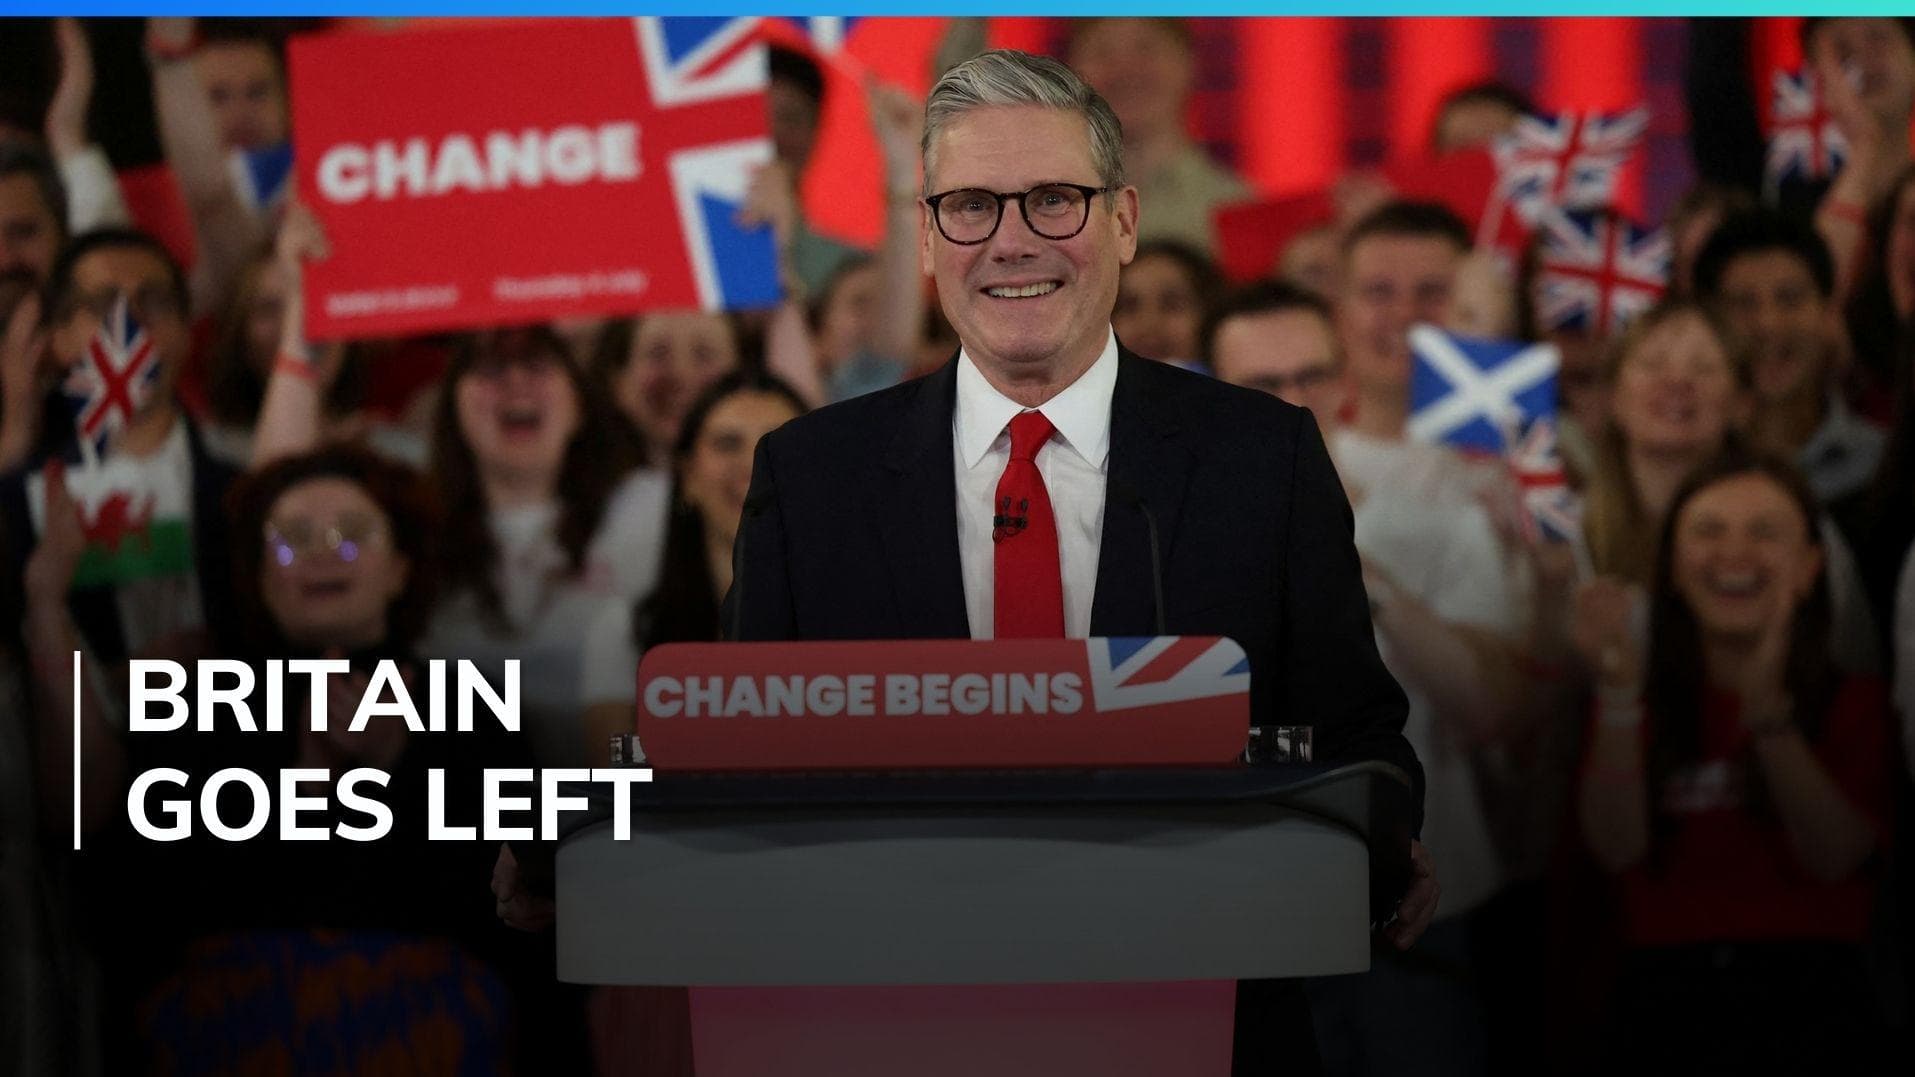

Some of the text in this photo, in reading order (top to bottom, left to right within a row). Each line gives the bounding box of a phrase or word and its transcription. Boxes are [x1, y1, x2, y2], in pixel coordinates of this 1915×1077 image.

[318, 123, 641, 201] CHANGE
[644, 671, 1084, 717] CHANGE BEGINS
